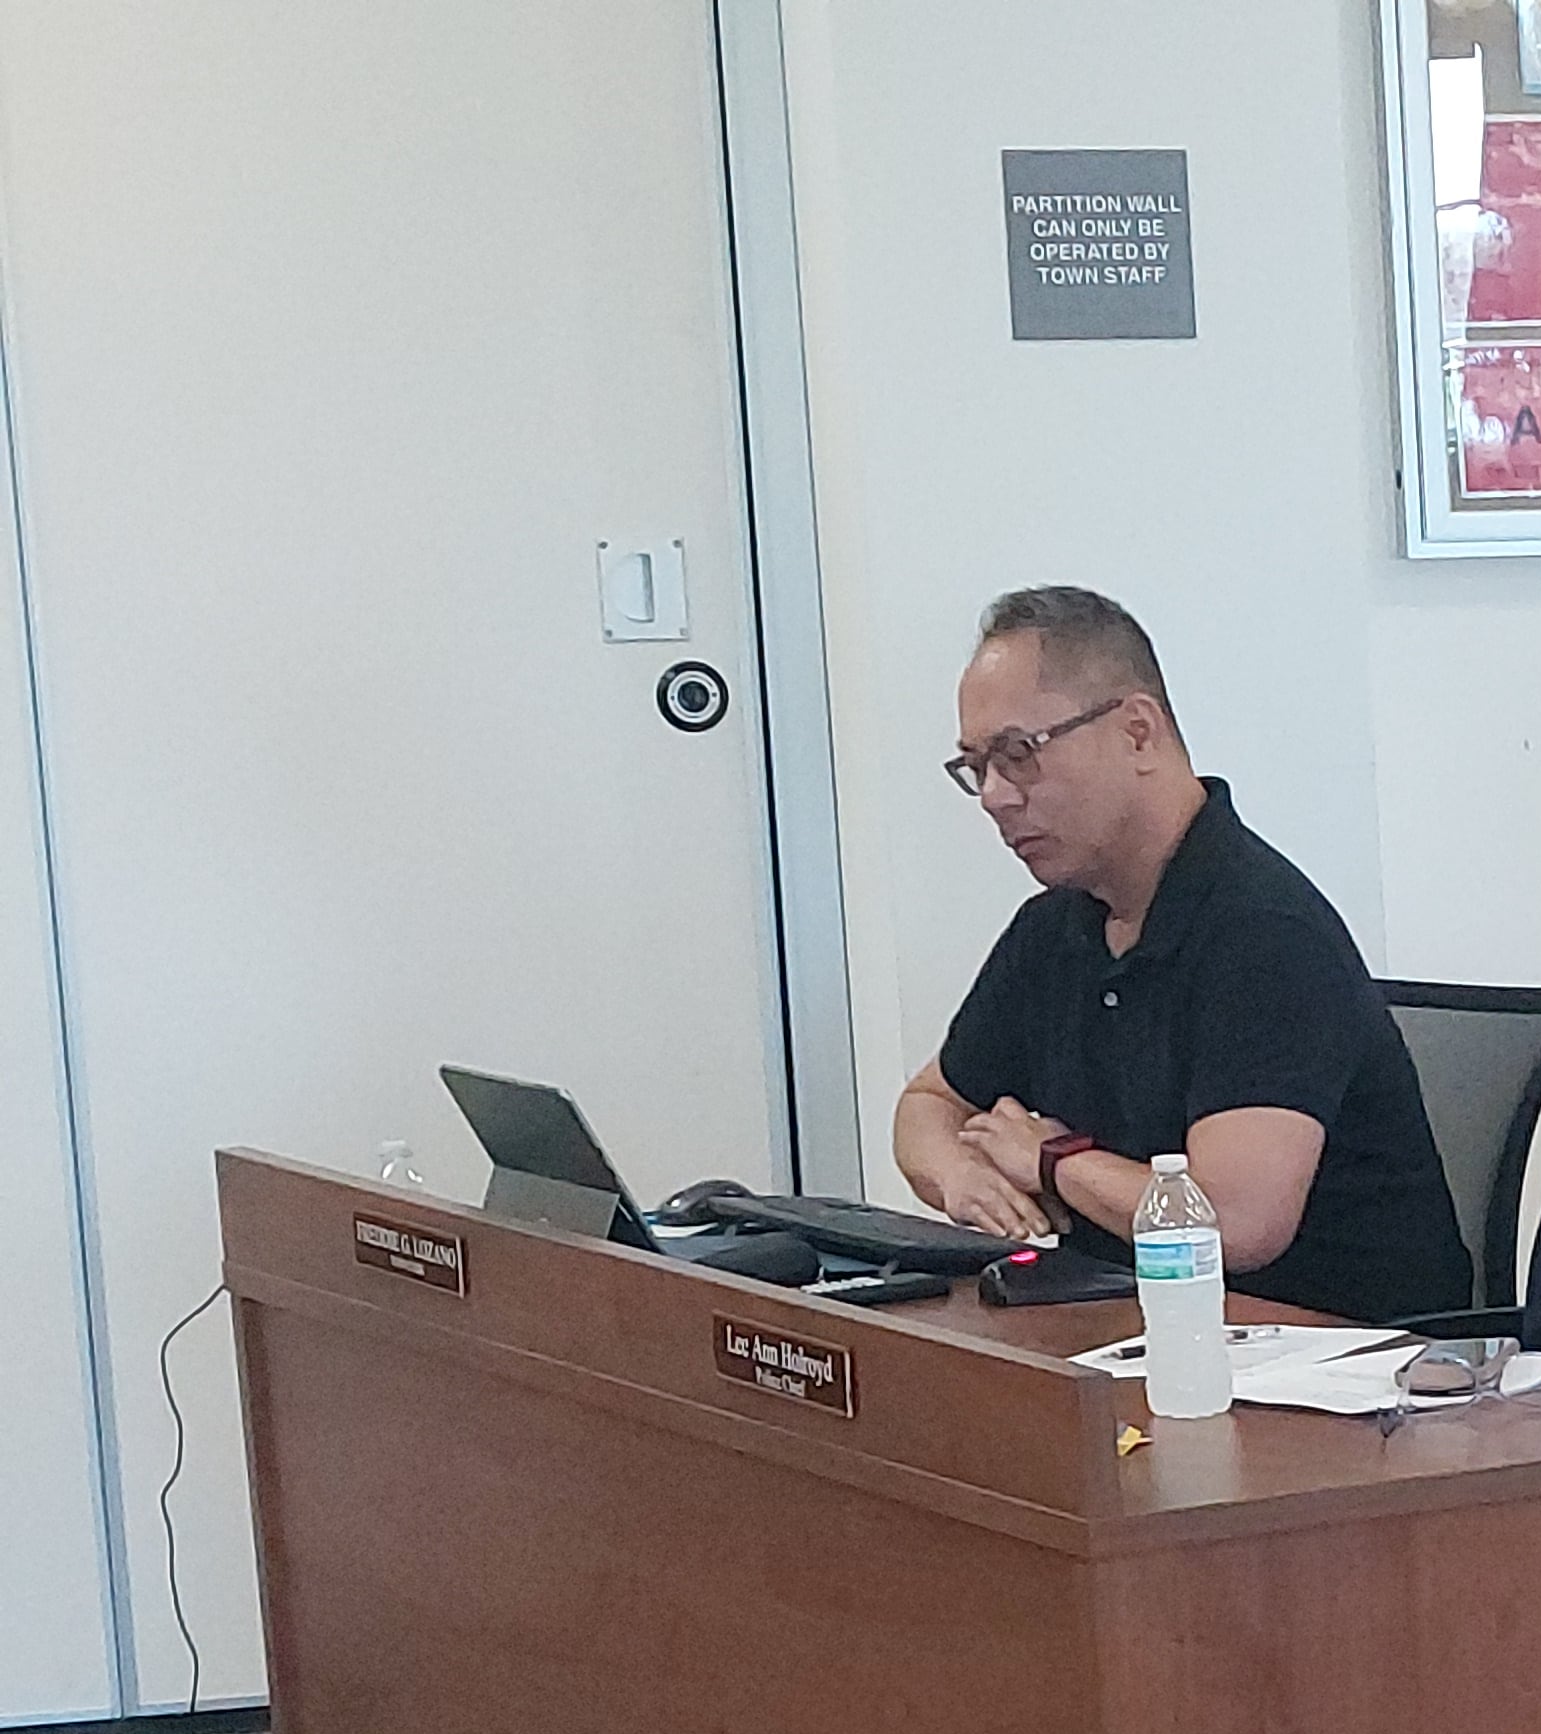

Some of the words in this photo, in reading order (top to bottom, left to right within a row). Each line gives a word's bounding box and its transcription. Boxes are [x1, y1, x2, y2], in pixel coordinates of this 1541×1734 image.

[1012, 195, 1122, 213] PARTITION
[1127, 195, 1182, 213] WALL
[1033, 219, 1076, 237] CAN
[1081, 219, 1131, 237] ONLY
[1138, 219, 1165, 236] BE
[1030, 243, 1138, 260] OPERATED
[1144, 243, 1169, 260] BY
[1035, 267, 1098, 284] TOWN
[1104, 266, 1167, 284] STAFF
[413, 1235, 457, 1269] LOZANO
[726, 1324, 749, 1358] Lee
[752, 1334, 778, 1365] Ann
[781, 1341, 834, 1387] Holroyd
